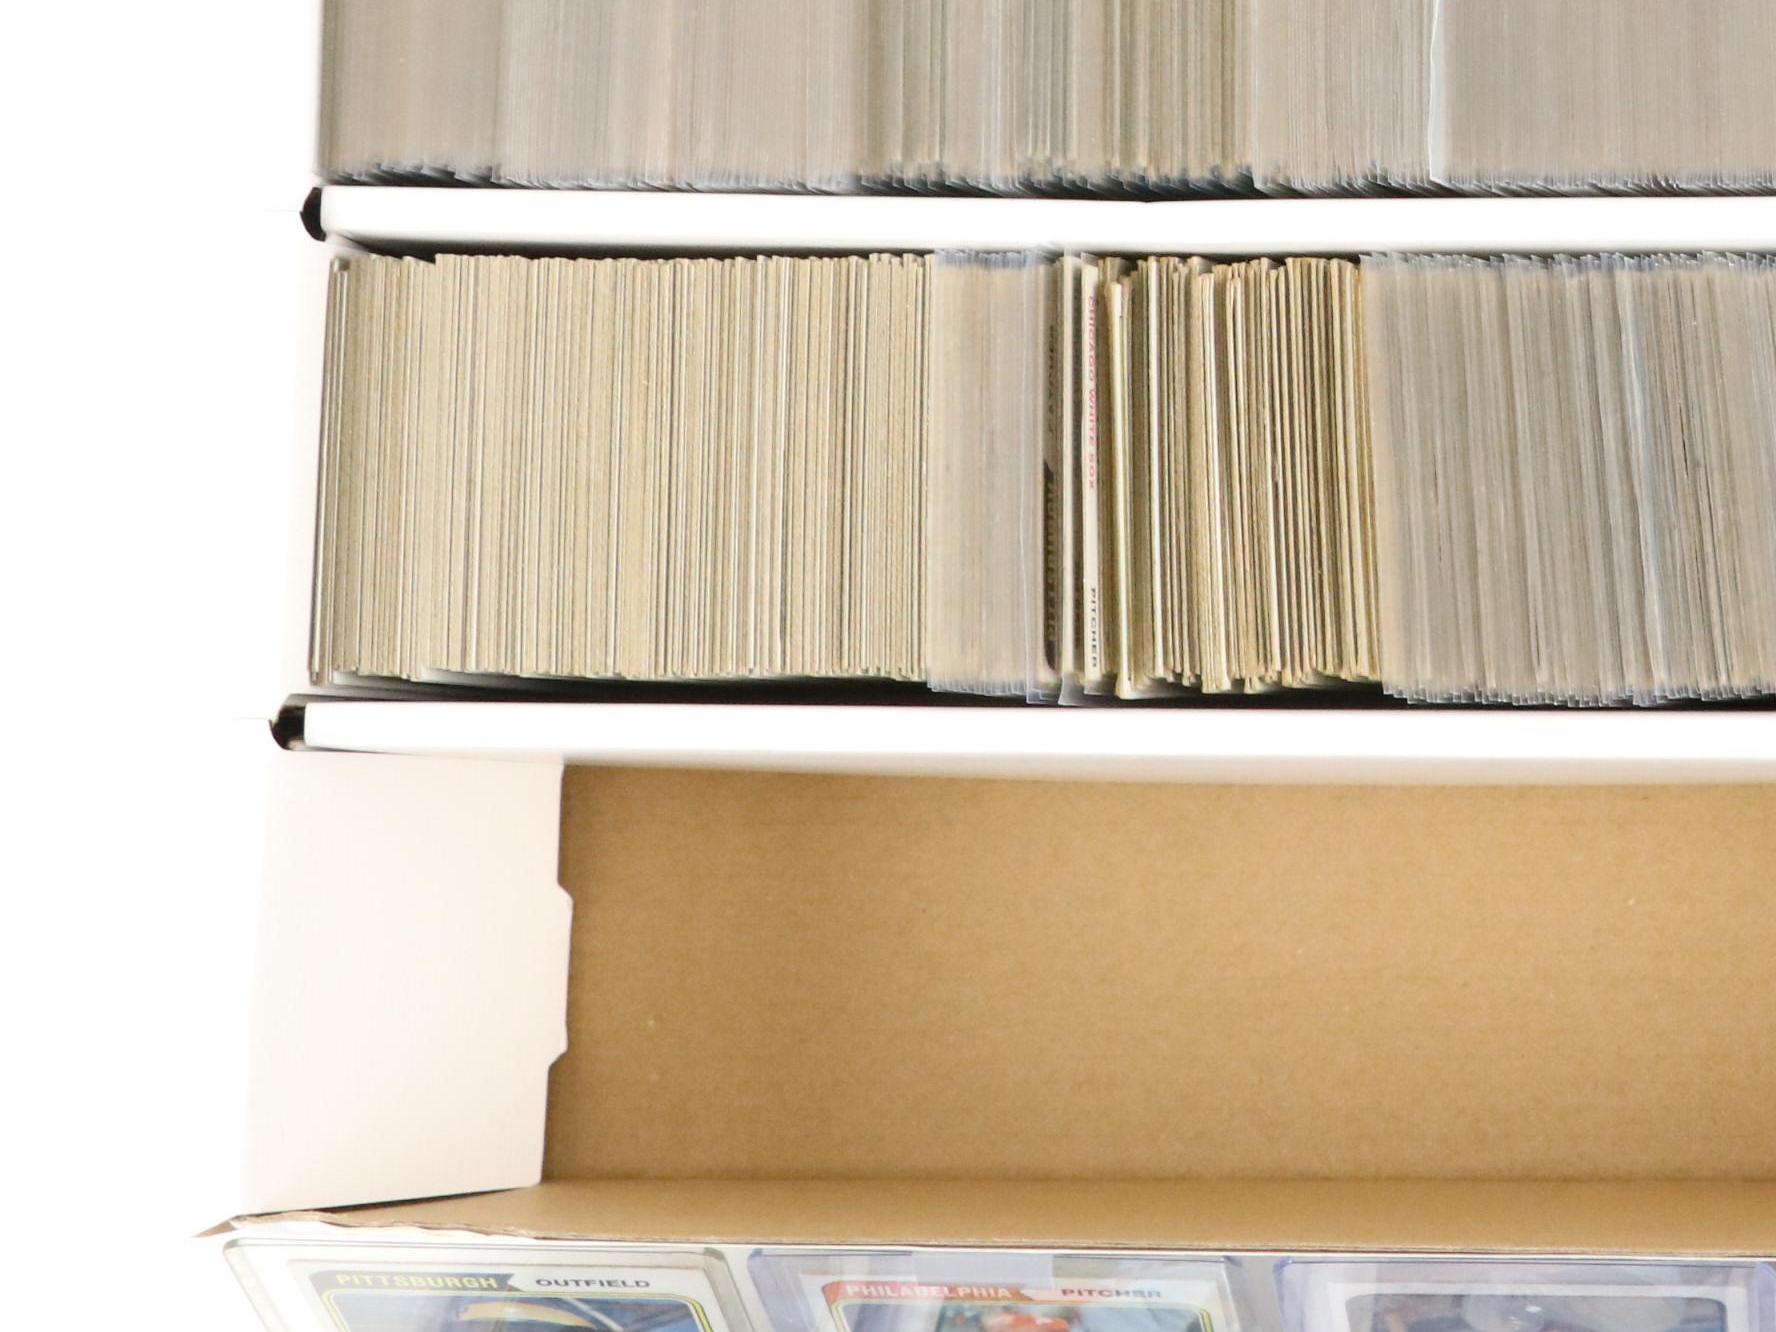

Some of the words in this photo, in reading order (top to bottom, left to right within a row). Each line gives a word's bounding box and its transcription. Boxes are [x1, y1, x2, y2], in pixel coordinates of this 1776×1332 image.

[334, 1271, 499, 1291] PITTSBURGH
[535, 1275, 651, 1290] OUTFIELD
[845, 1283, 1012, 1300] PHILADELPHIA
[1061, 1287, 1162, 1300] PITCHER
